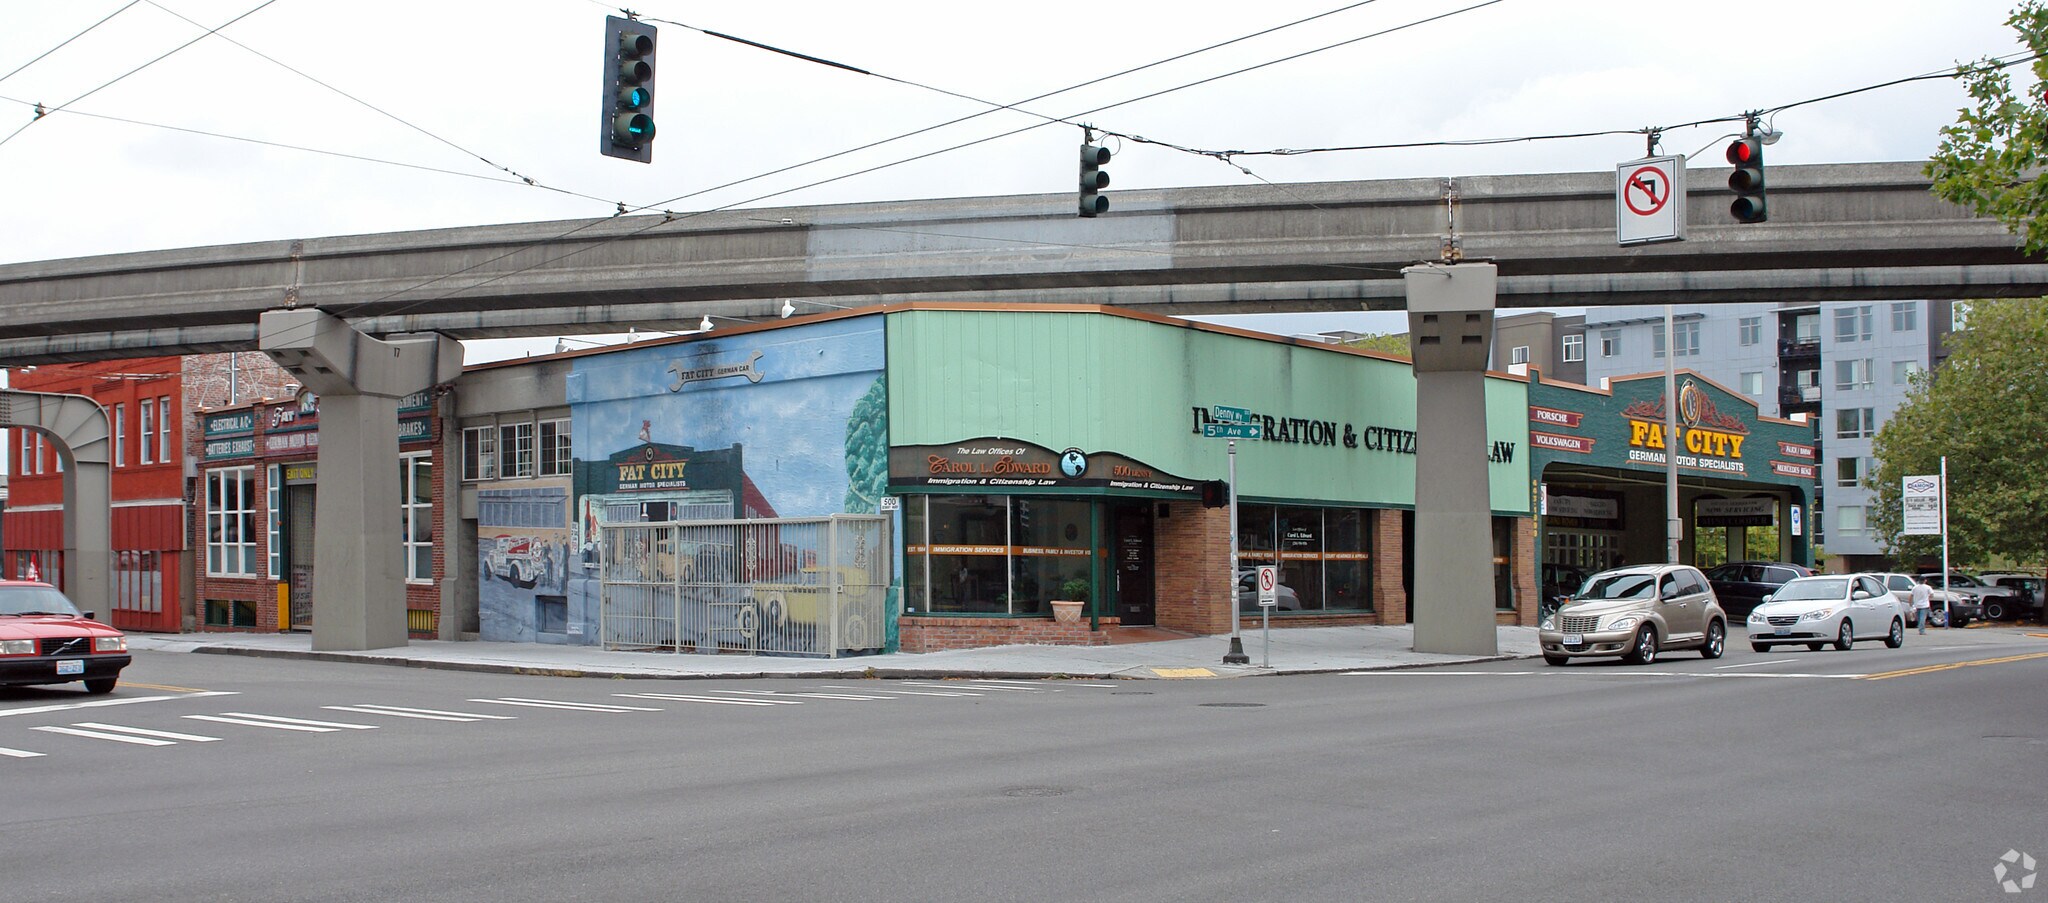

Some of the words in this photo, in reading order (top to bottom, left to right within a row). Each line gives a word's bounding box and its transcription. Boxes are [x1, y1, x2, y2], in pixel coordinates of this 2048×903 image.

[394, 347, 400, 358] 17
[681, 371, 695, 381] FAT
[696, 369, 715, 379] CITY
[717, 367, 738, 375] GERMAN
[1215, 406, 1234, 420] Denny
[1235, 412, 1243, 421] Wy
[1536, 410, 1568, 423] PORSCHE
[213, 417, 239, 432] ELECTRICAL
[1192, 406, 1337, 446] IRATION
[1343, 423, 1359, 449] &
[1364, 425, 1417, 455] CITIZ
[1207, 425, 1224, 437] 5th
[1227, 427, 1242, 436] Ave
[208, 442, 231, 455] BATTERIES
[232, 440, 253, 453] EXHAUST
[1535, 434, 1581, 449] VOLKSWAGEN
[1685, 428, 1745, 458] CITY
[957, 447, 971, 455] The
[971, 447, 987, 455] Law
[988, 447, 1013, 455] Offices
[1015, 447, 1025, 455] Of
[1629, 449, 1666, 463] GERMAN
[1676, 455, 1697, 467] OTOR
[1699, 458, 1744, 472] SPECIALISTS
[286, 467, 299, 480] EXIT
[300, 467, 314, 479] ONLY
[619, 464, 645, 481] FAT
[651, 461, 686, 480] CITY
[980, 462, 991, 474] L.
[1114, 465, 1130, 477] 500
[1776, 464, 1800, 474] MERCEDES
[657, 480, 686, 488] SPECIALISTS
[927, 477, 977, 486] Immigration
[989, 478, 1036, 487] Citizenship
[1110, 480, 1142, 489] Immigration
[1150, 482, 1181, 491] Citizenship
[884, 497, 897, 506] 500
